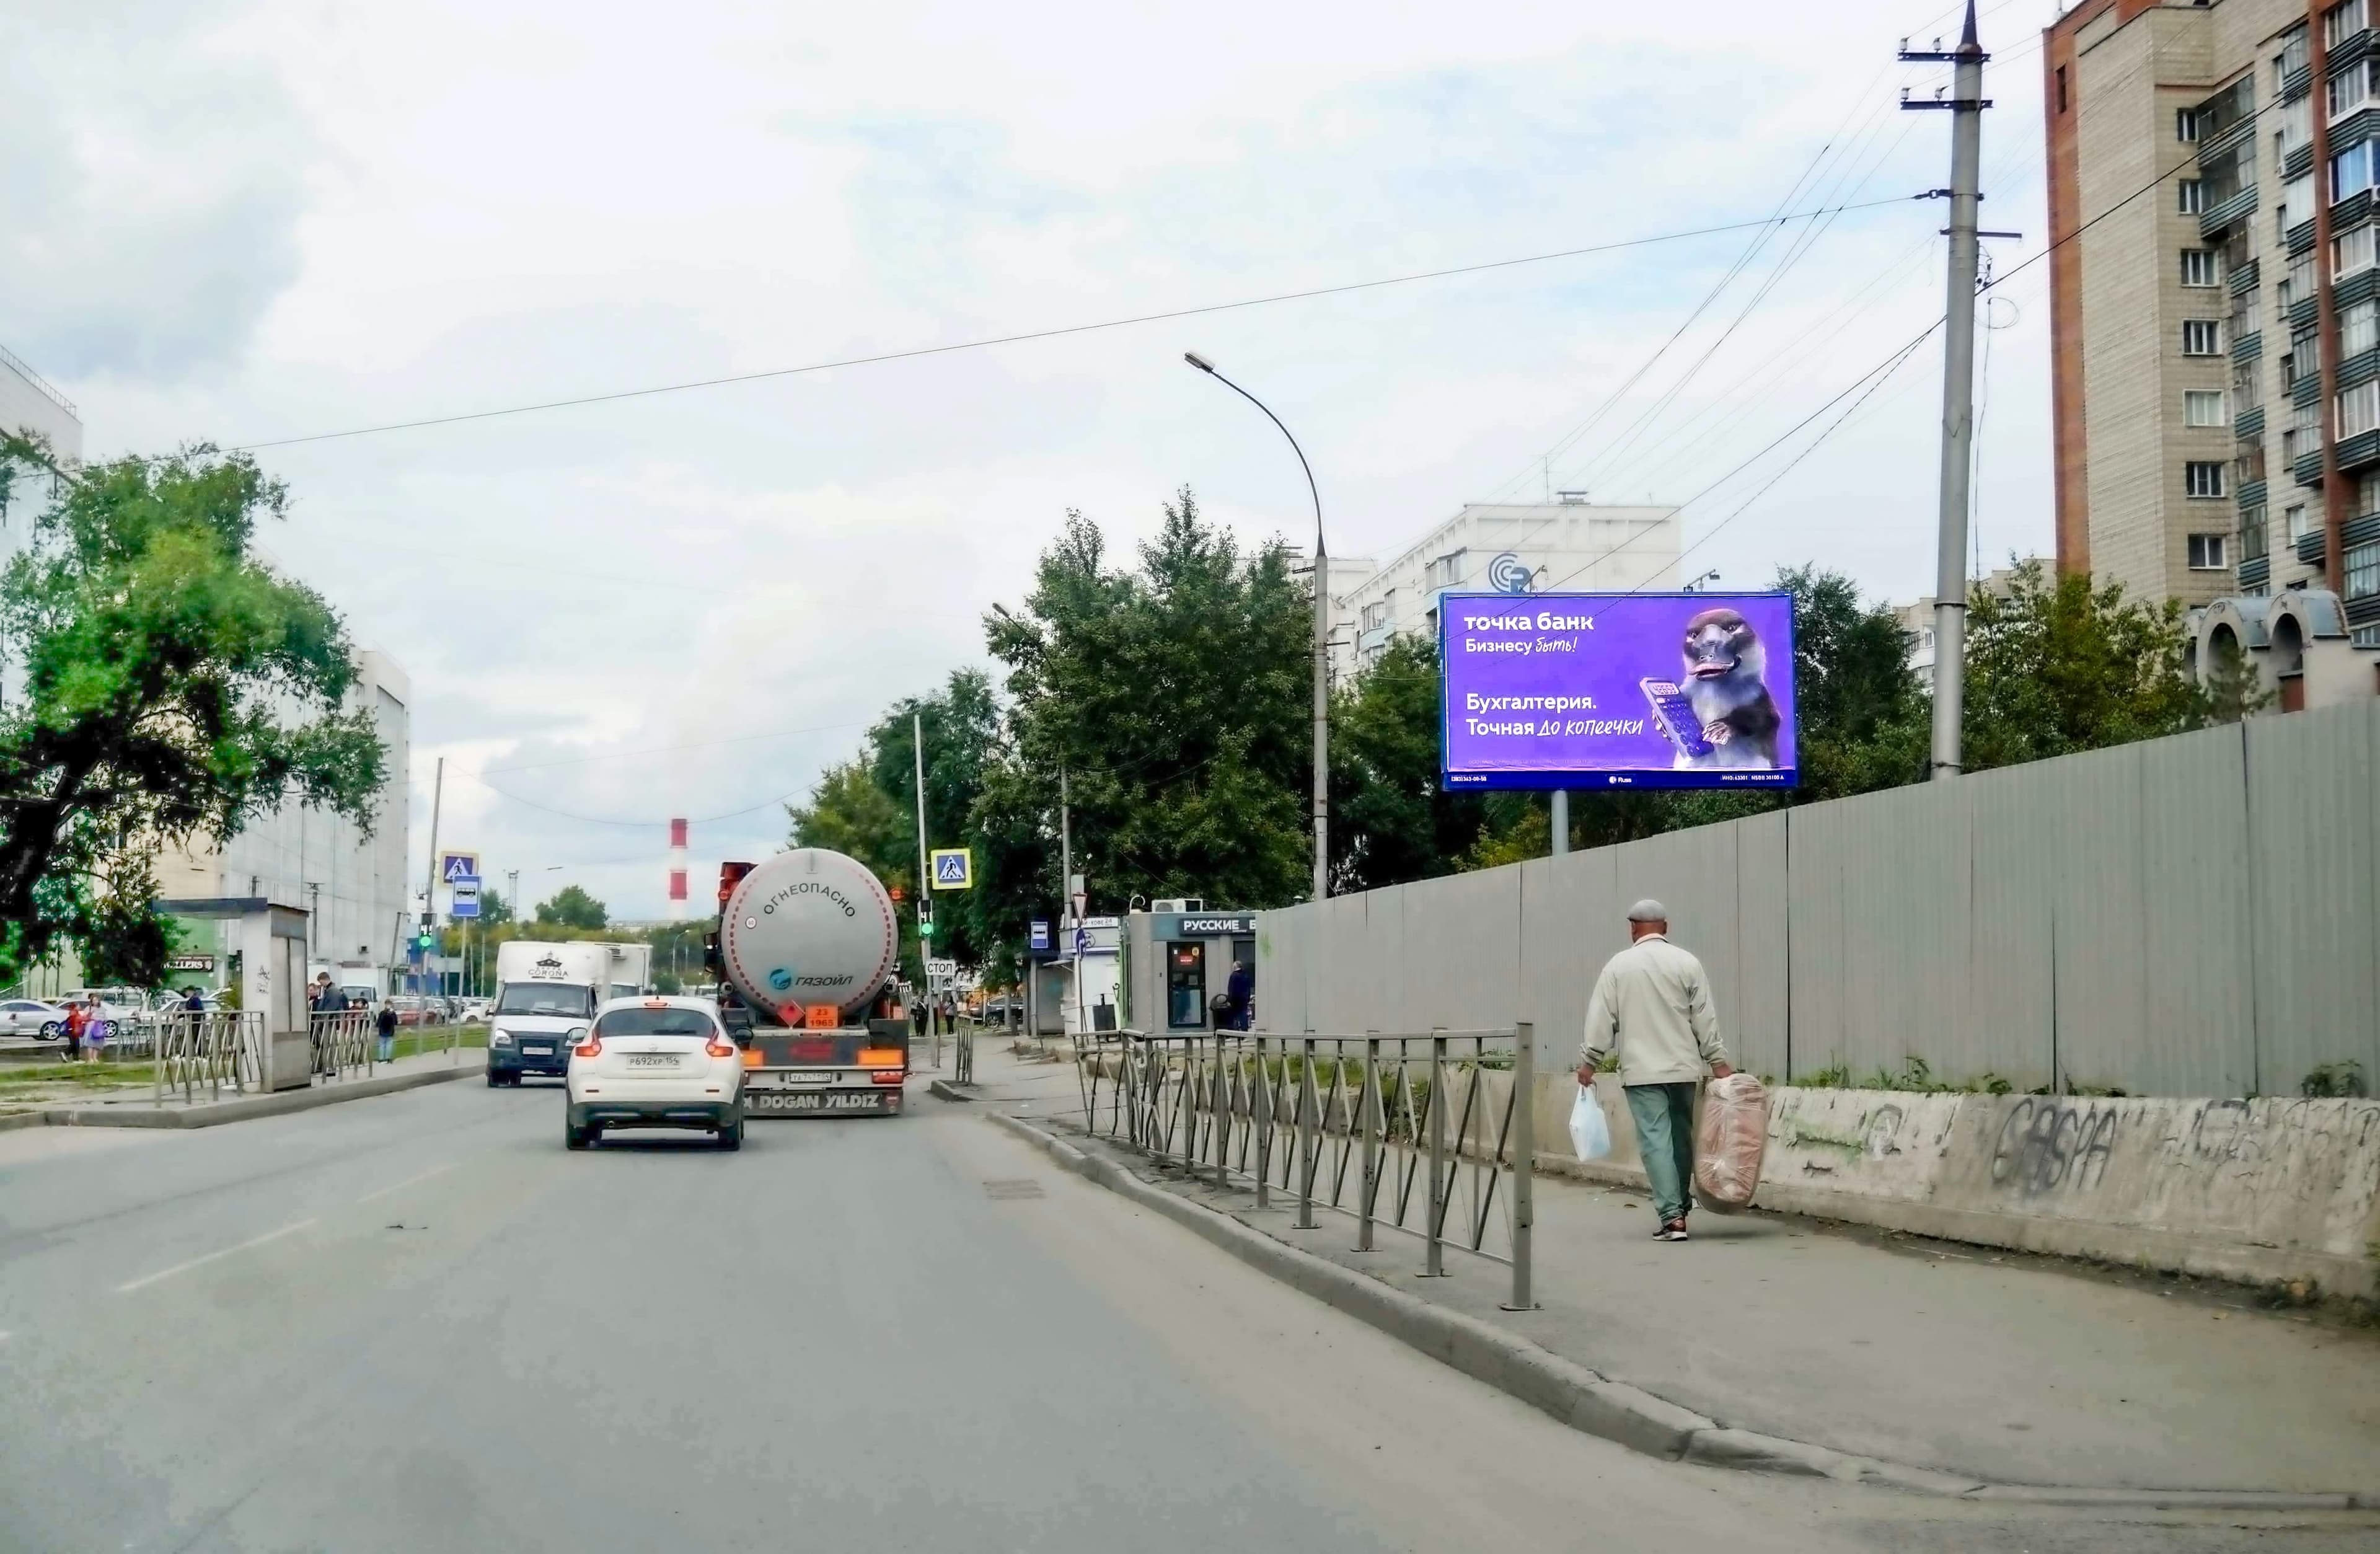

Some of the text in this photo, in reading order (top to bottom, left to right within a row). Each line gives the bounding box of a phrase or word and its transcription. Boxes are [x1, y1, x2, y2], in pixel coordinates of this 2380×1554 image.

[1464, 612, 1594, 630] точка банк
[1466, 637, 1578, 655] Бизнесу быть!
[1466, 693, 1597, 713] Бухгалтерия.
[1466, 718, 1534, 735] Точная
[1564, 719, 1644, 736] копеечки
[764, 883, 855, 917] ОГНЕОПАСНО
[1184, 920, 1240, 930] РУССКИЕ
[528, 969, 568, 977] CORONA
[927, 963, 953, 973] СТОП
[795, 974, 853, 986] ГАЗОЙЛ
[759, 1095, 820, 1108] DOGAN
